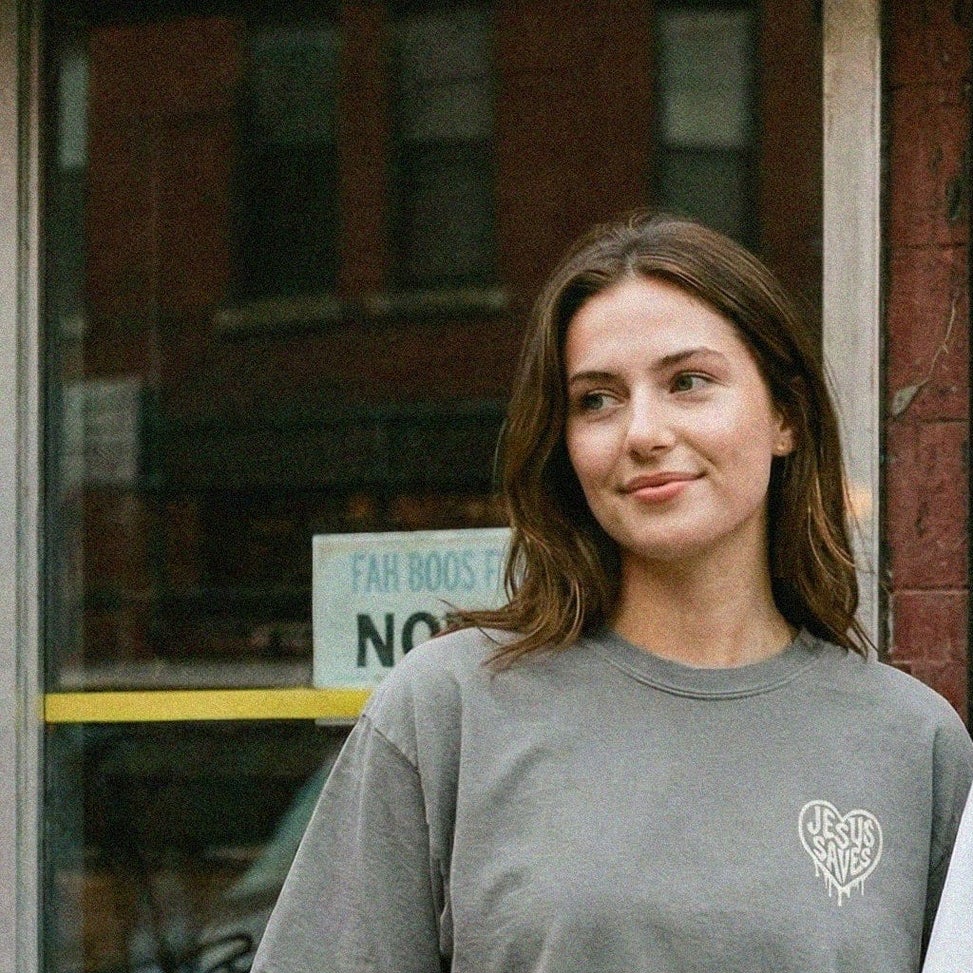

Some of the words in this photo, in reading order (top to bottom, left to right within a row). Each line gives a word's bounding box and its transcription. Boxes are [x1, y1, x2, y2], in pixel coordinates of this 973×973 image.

[356, 611, 456, 668] NO
[807, 805, 875, 850] JESUS
[813, 835, 872, 884] SAVES
